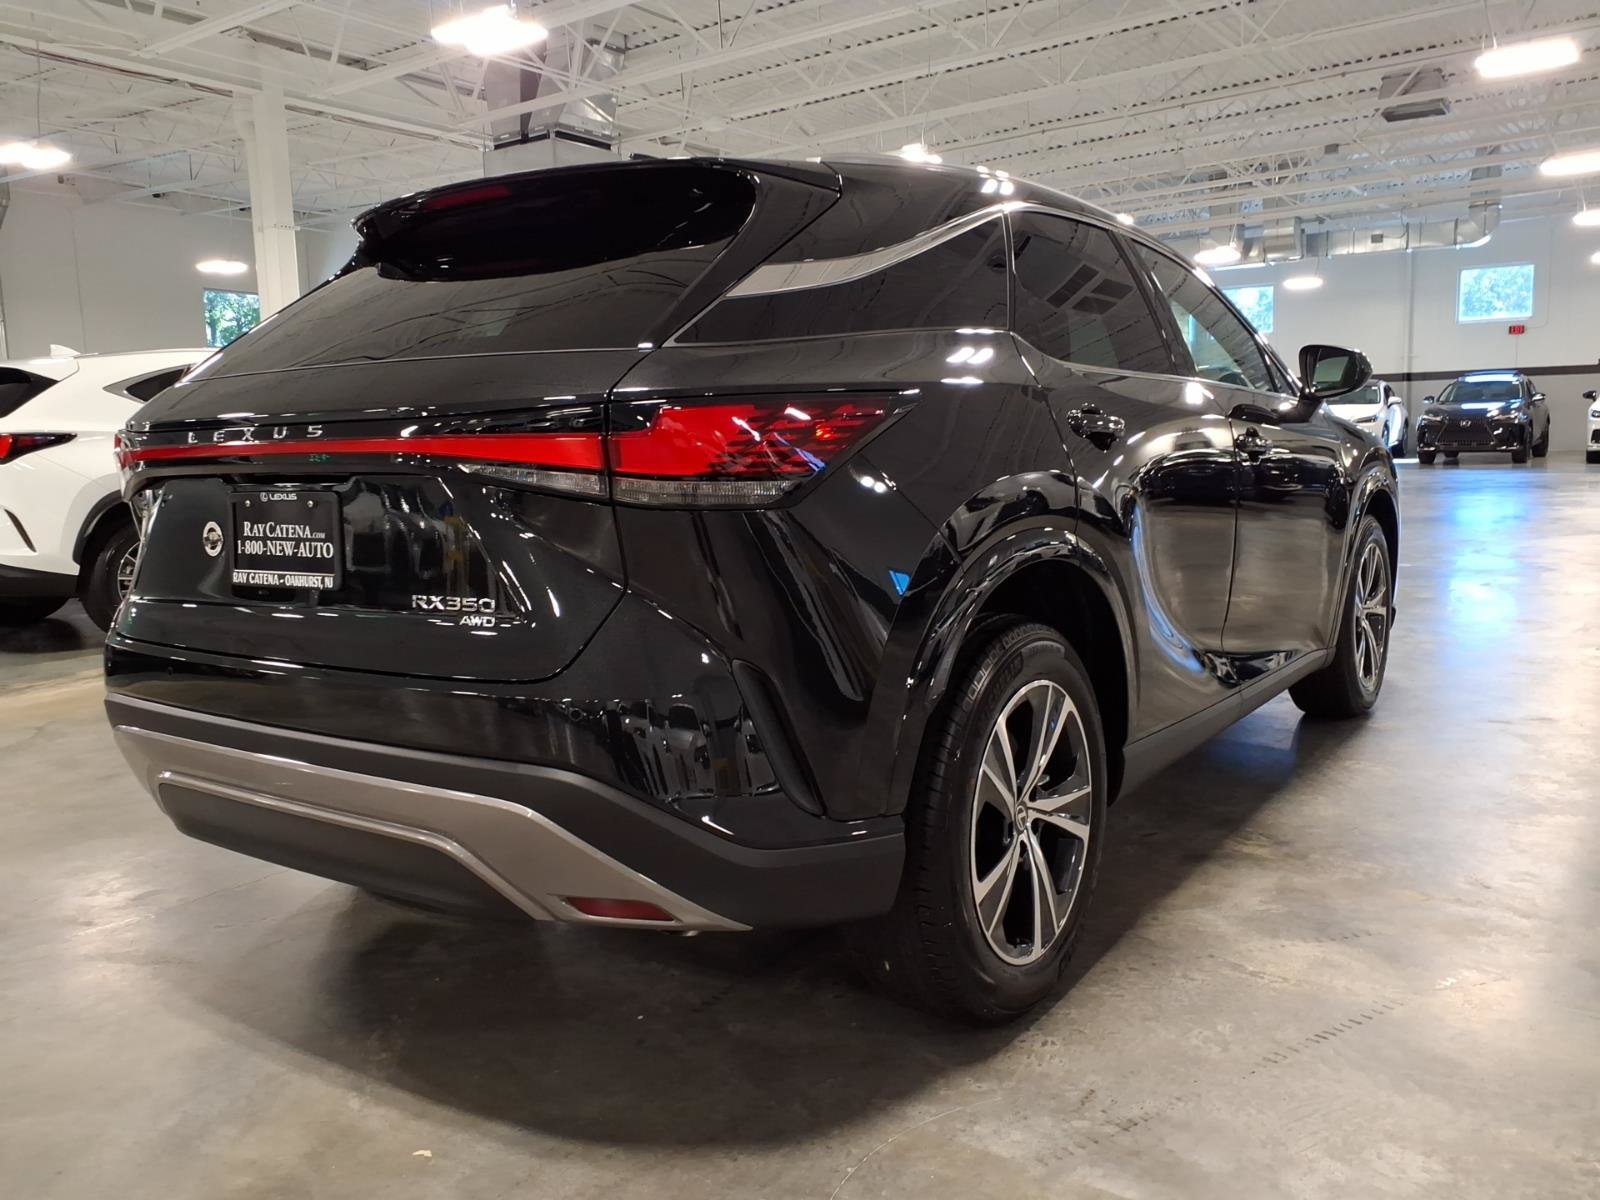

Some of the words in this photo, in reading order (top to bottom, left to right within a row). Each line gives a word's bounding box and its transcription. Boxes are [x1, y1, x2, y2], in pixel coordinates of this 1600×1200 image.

[187, 425, 323, 444] LEXUS
[269, 493, 297, 501] LEXUS
[237, 540, 334, 558] 1-800-NEW-AUTO
[233, 572, 247, 584] RAY
[249, 572, 279, 585] CATENA
[324, 576, 334, 588] NJ
[411, 595, 496, 613] RX350
[459, 615, 496, 627] AWD
